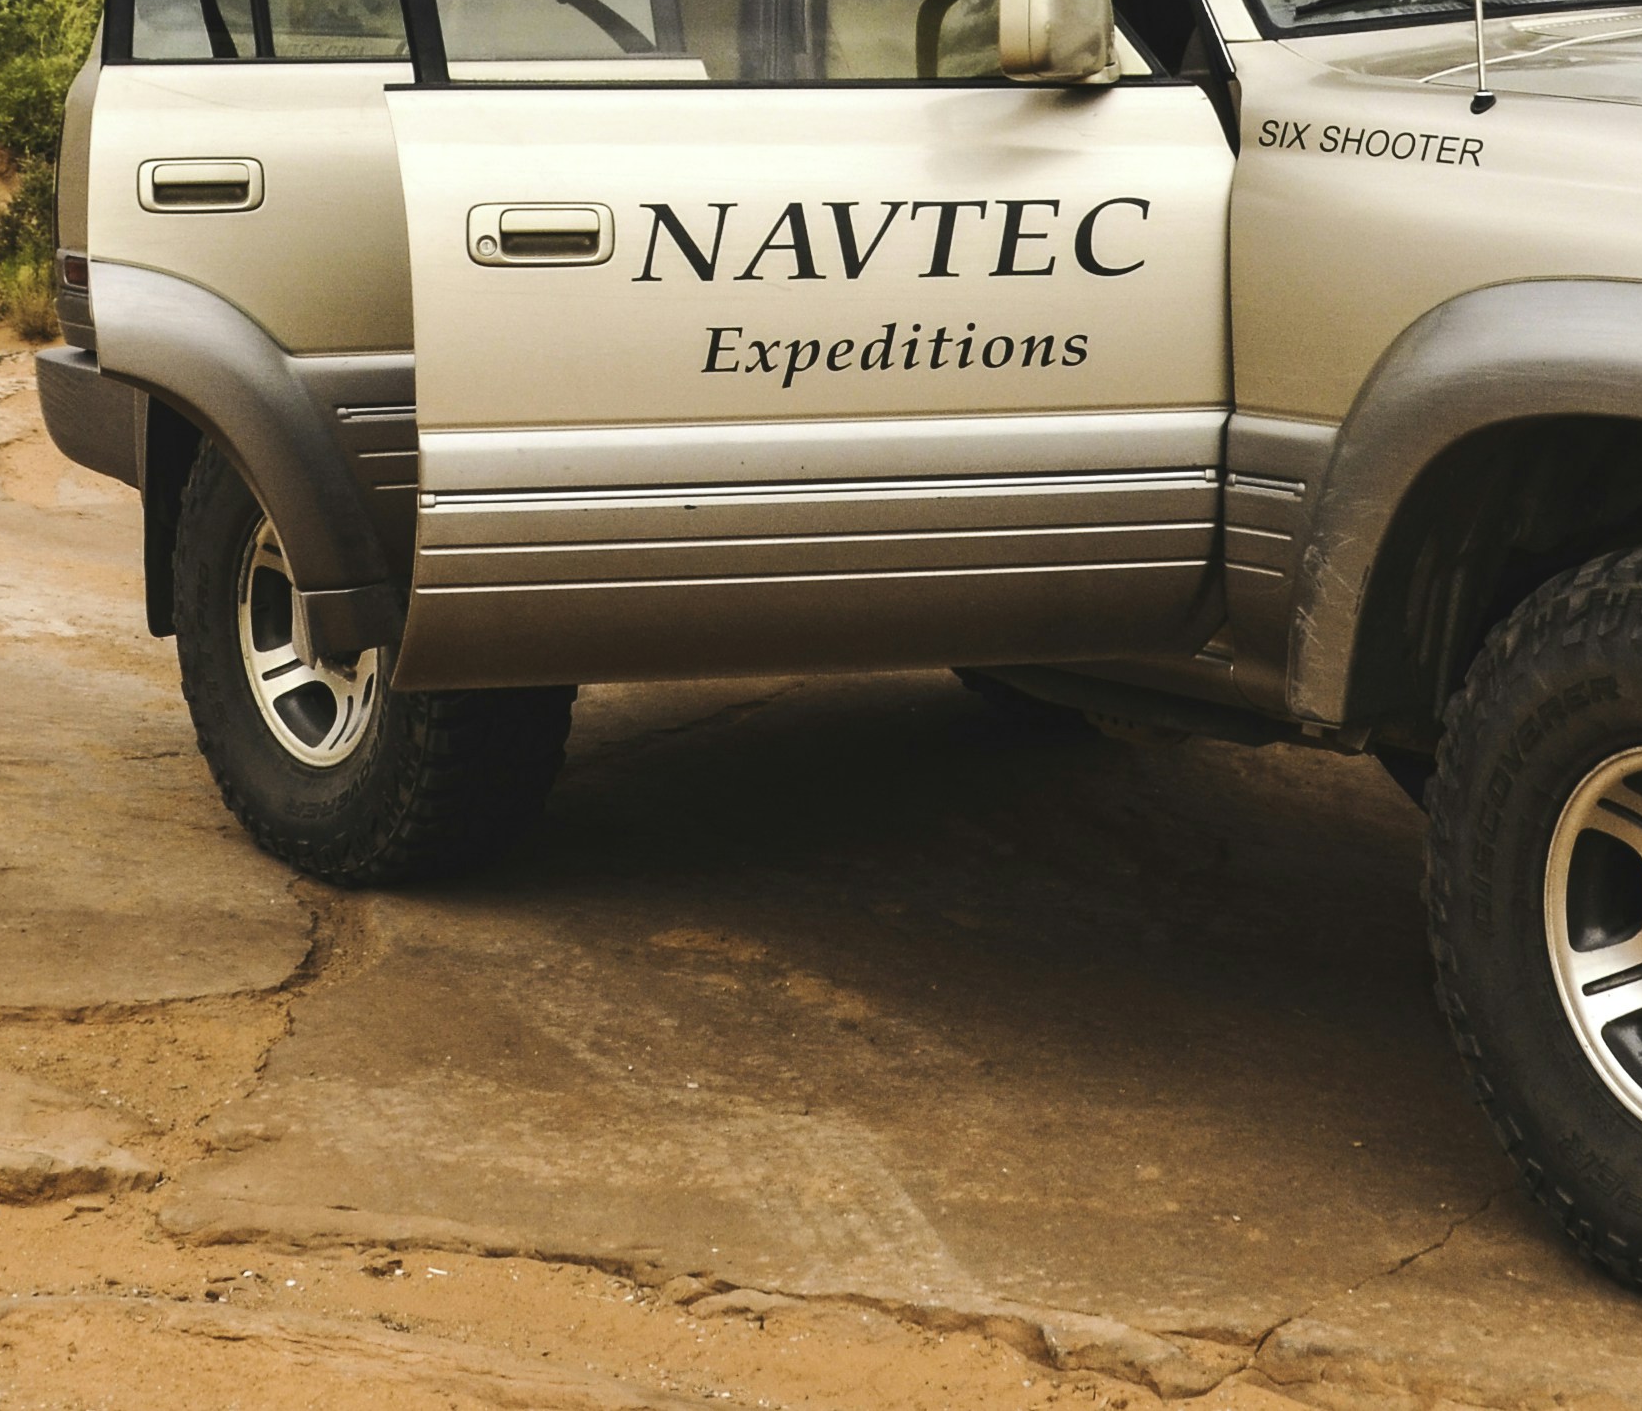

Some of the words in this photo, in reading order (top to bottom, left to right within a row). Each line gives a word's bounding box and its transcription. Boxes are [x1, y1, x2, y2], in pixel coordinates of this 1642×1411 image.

[1258, 119, 1311, 150] SIX
[1319, 125, 1484, 167] SHOOTER
[631, 196, 1150, 282] NAVTEC
[700, 322, 1089, 389] Expeditions
[1470, 674, 1621, 936] DISCOVERER
